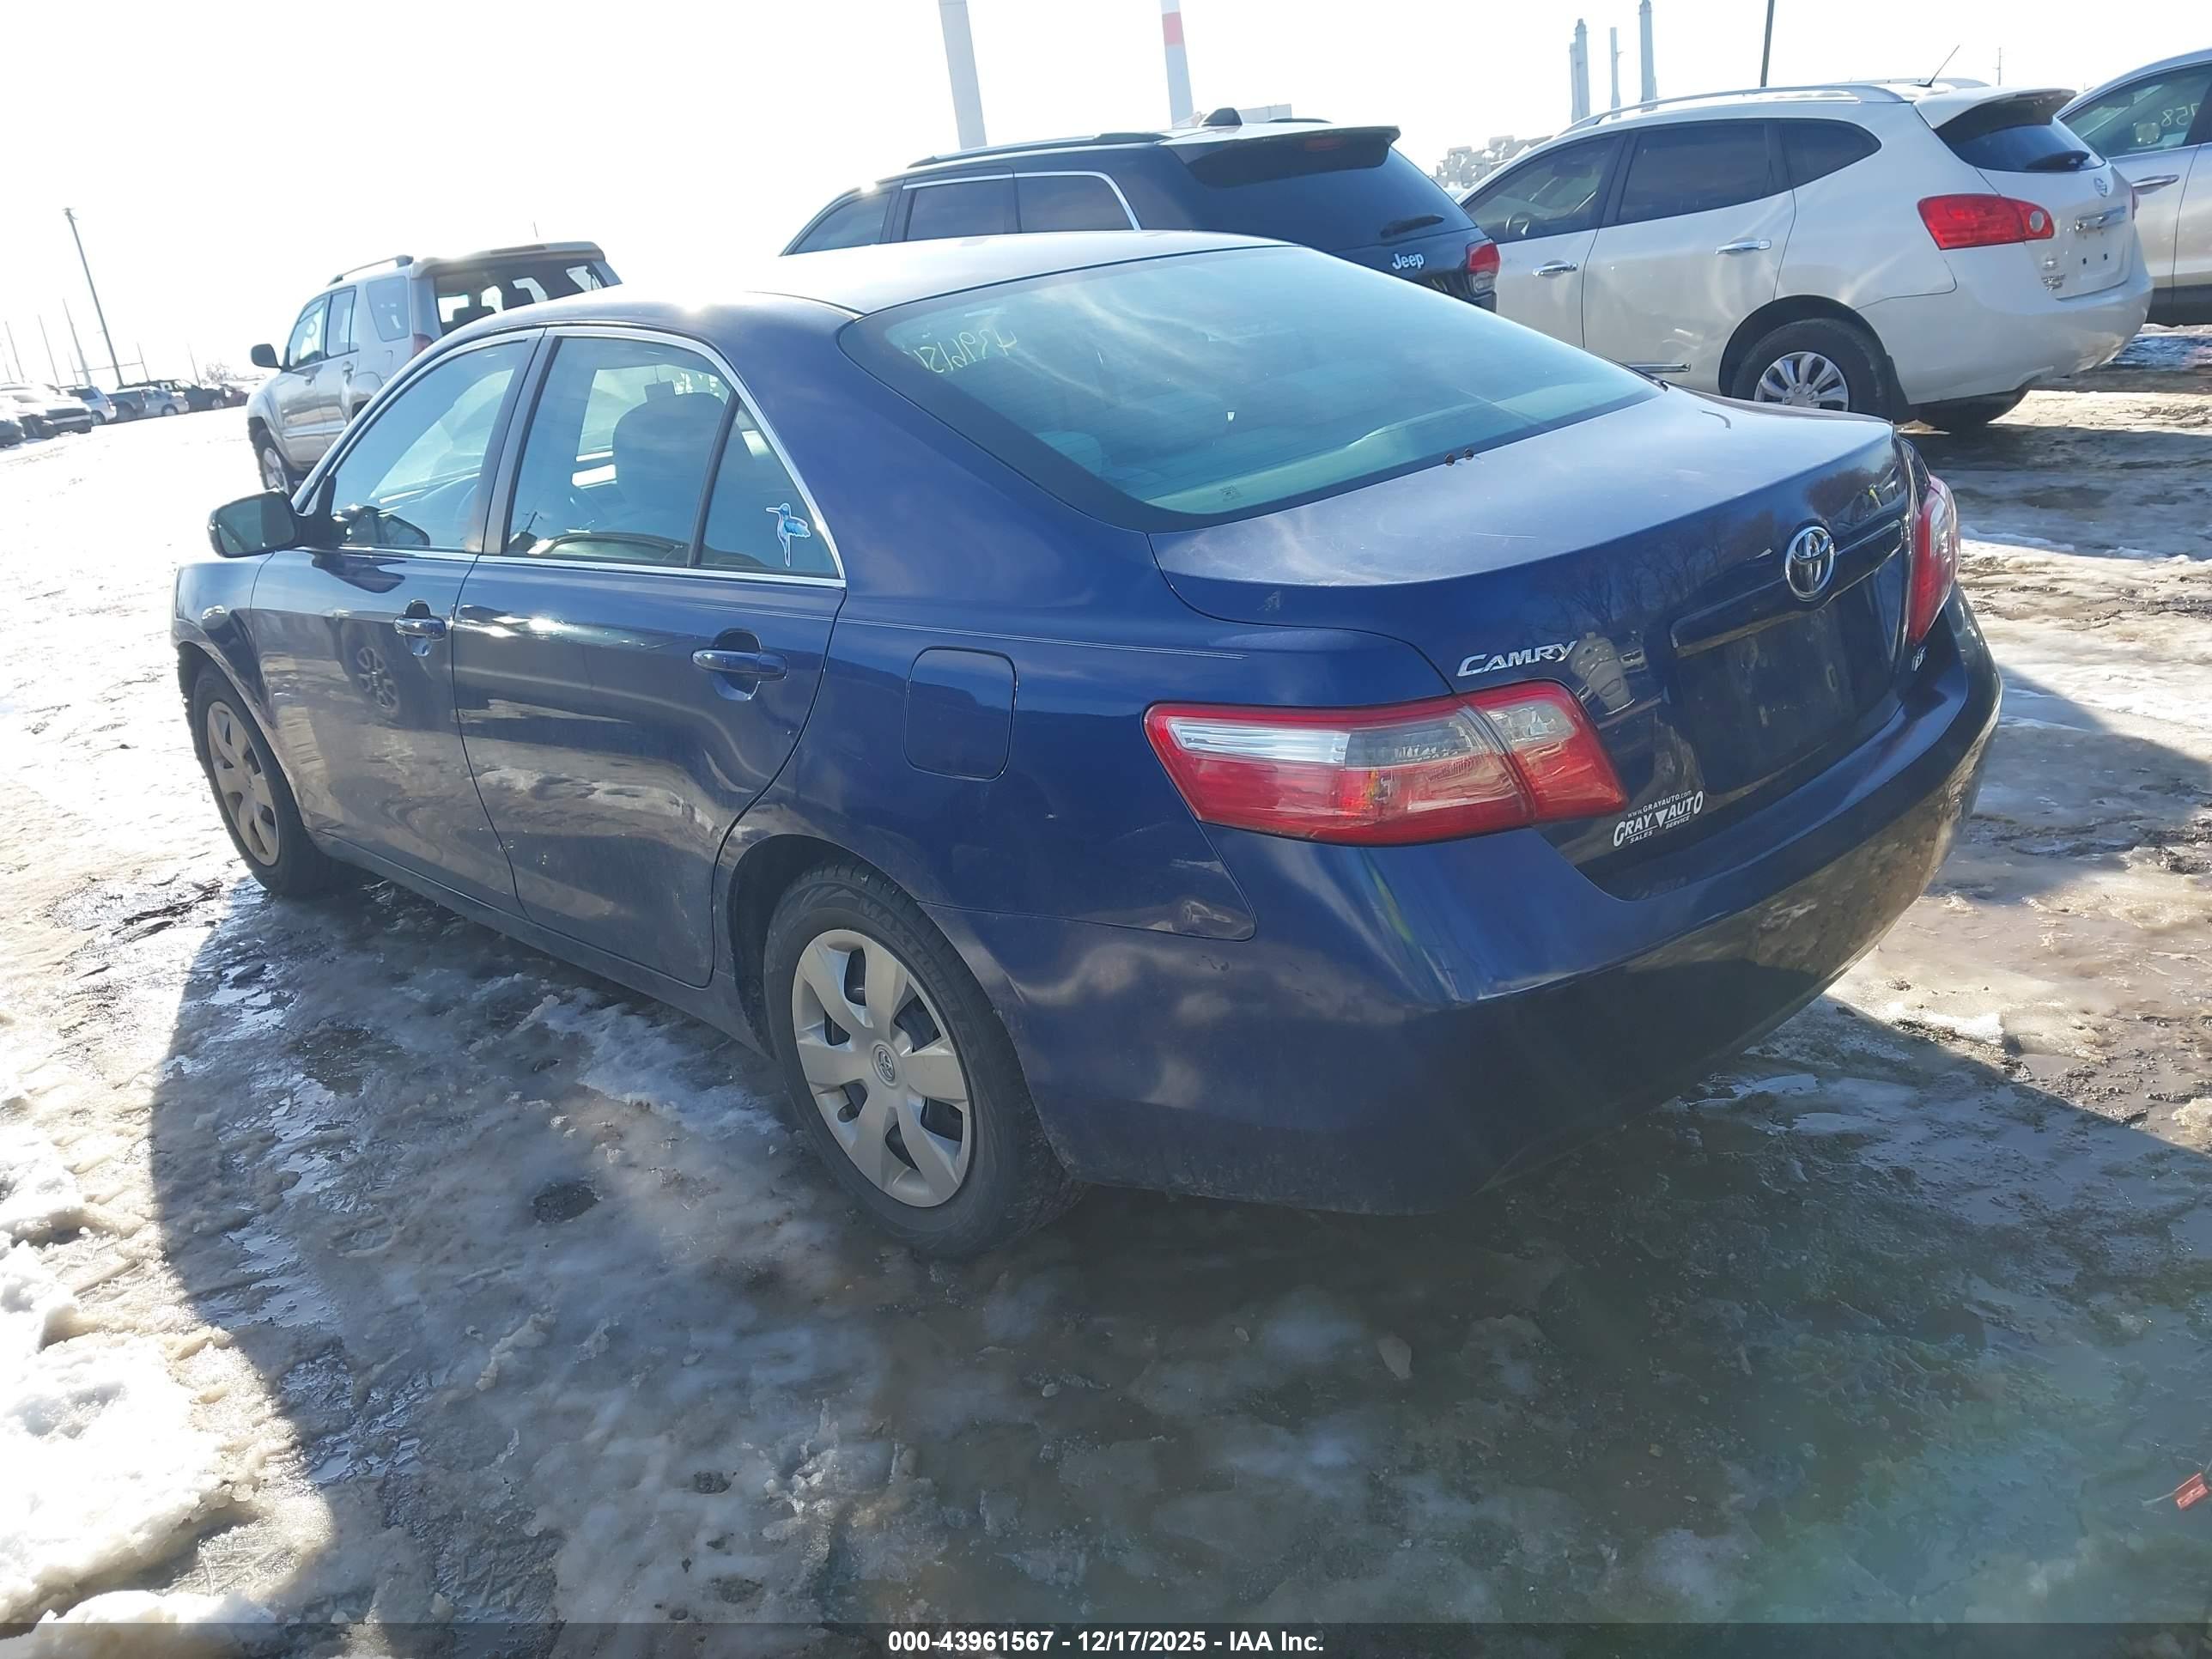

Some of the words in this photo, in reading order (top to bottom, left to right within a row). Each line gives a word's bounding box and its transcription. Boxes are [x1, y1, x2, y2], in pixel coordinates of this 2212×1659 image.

[1392, 252, 1425, 270] Jeep
[1456, 640, 1577, 677] CAMRY
[1667, 790, 1704, 820] AUTO
[1665, 815, 1690, 830] SERVICE
[1630, 830, 1653, 844] SALES
